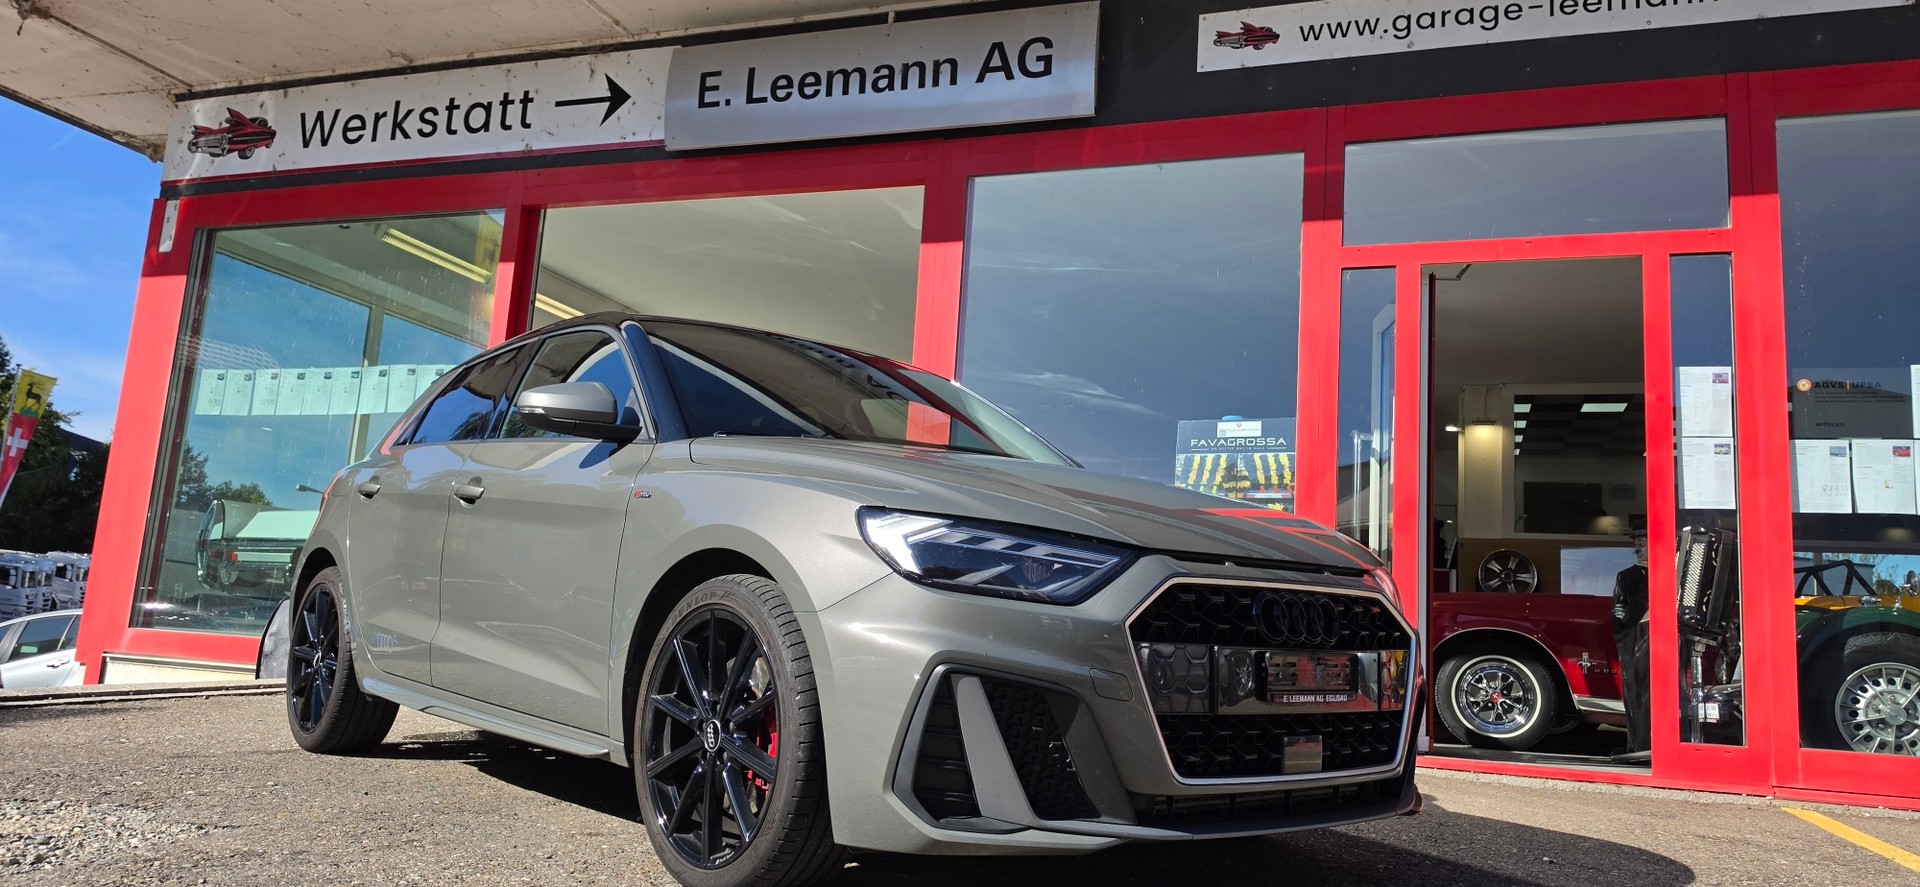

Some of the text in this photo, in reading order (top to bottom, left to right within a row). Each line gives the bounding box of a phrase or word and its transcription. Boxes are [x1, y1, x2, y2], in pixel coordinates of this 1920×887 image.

[698, 36, 1054, 109] E. Leemann AG
[300, 90, 535, 149] Werkstatt
[1190, 437, 1287, 447] FAVAGROSSA
[1290, 694, 1315, 702] LEEMANN
[1316, 694, 1324, 702] AG
[1326, 694, 1348, 702] EGLISAU
